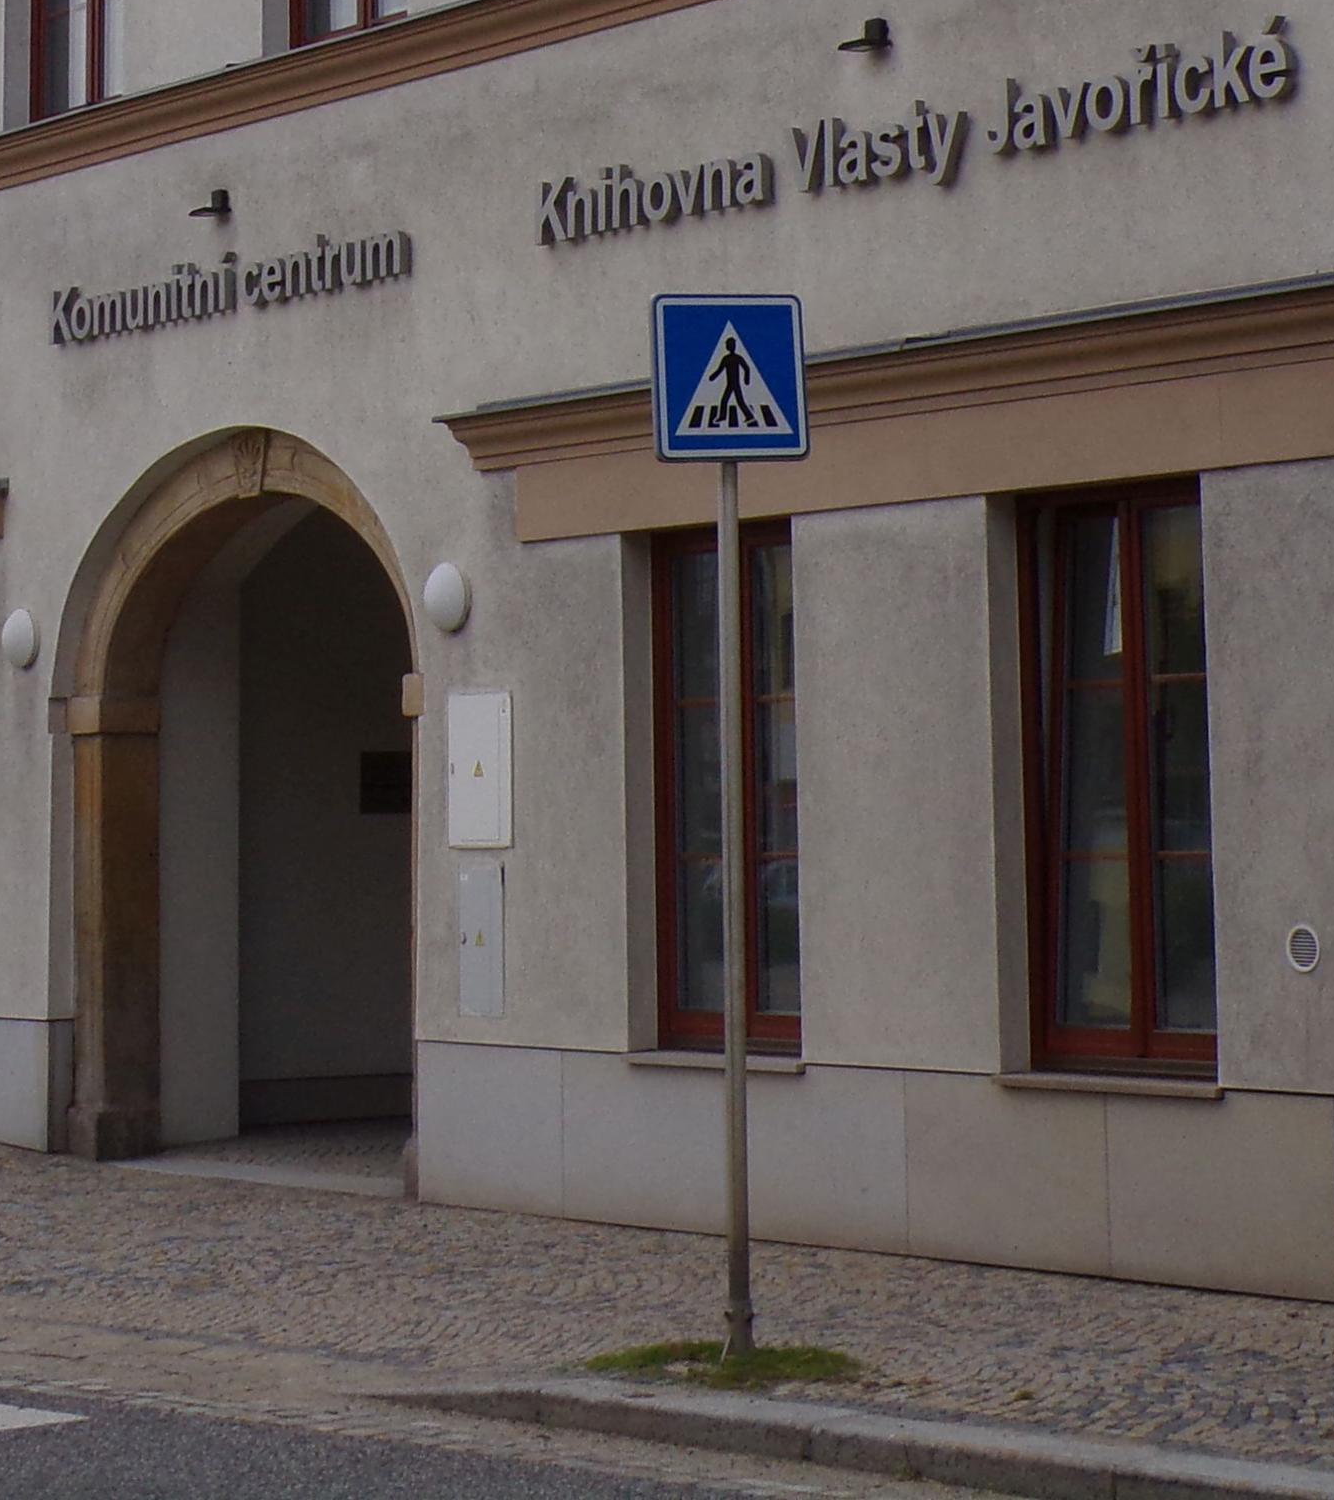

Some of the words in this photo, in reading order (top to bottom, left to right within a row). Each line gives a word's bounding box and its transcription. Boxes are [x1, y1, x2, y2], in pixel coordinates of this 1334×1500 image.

[535, 151, 774, 246] Knihovna
[791, 100, 969, 193] Vlasty
[985, 15, 1296, 155] Javořické
[49, 251, 238, 345] Komunitní
[241, 229, 413, 307] centrum
